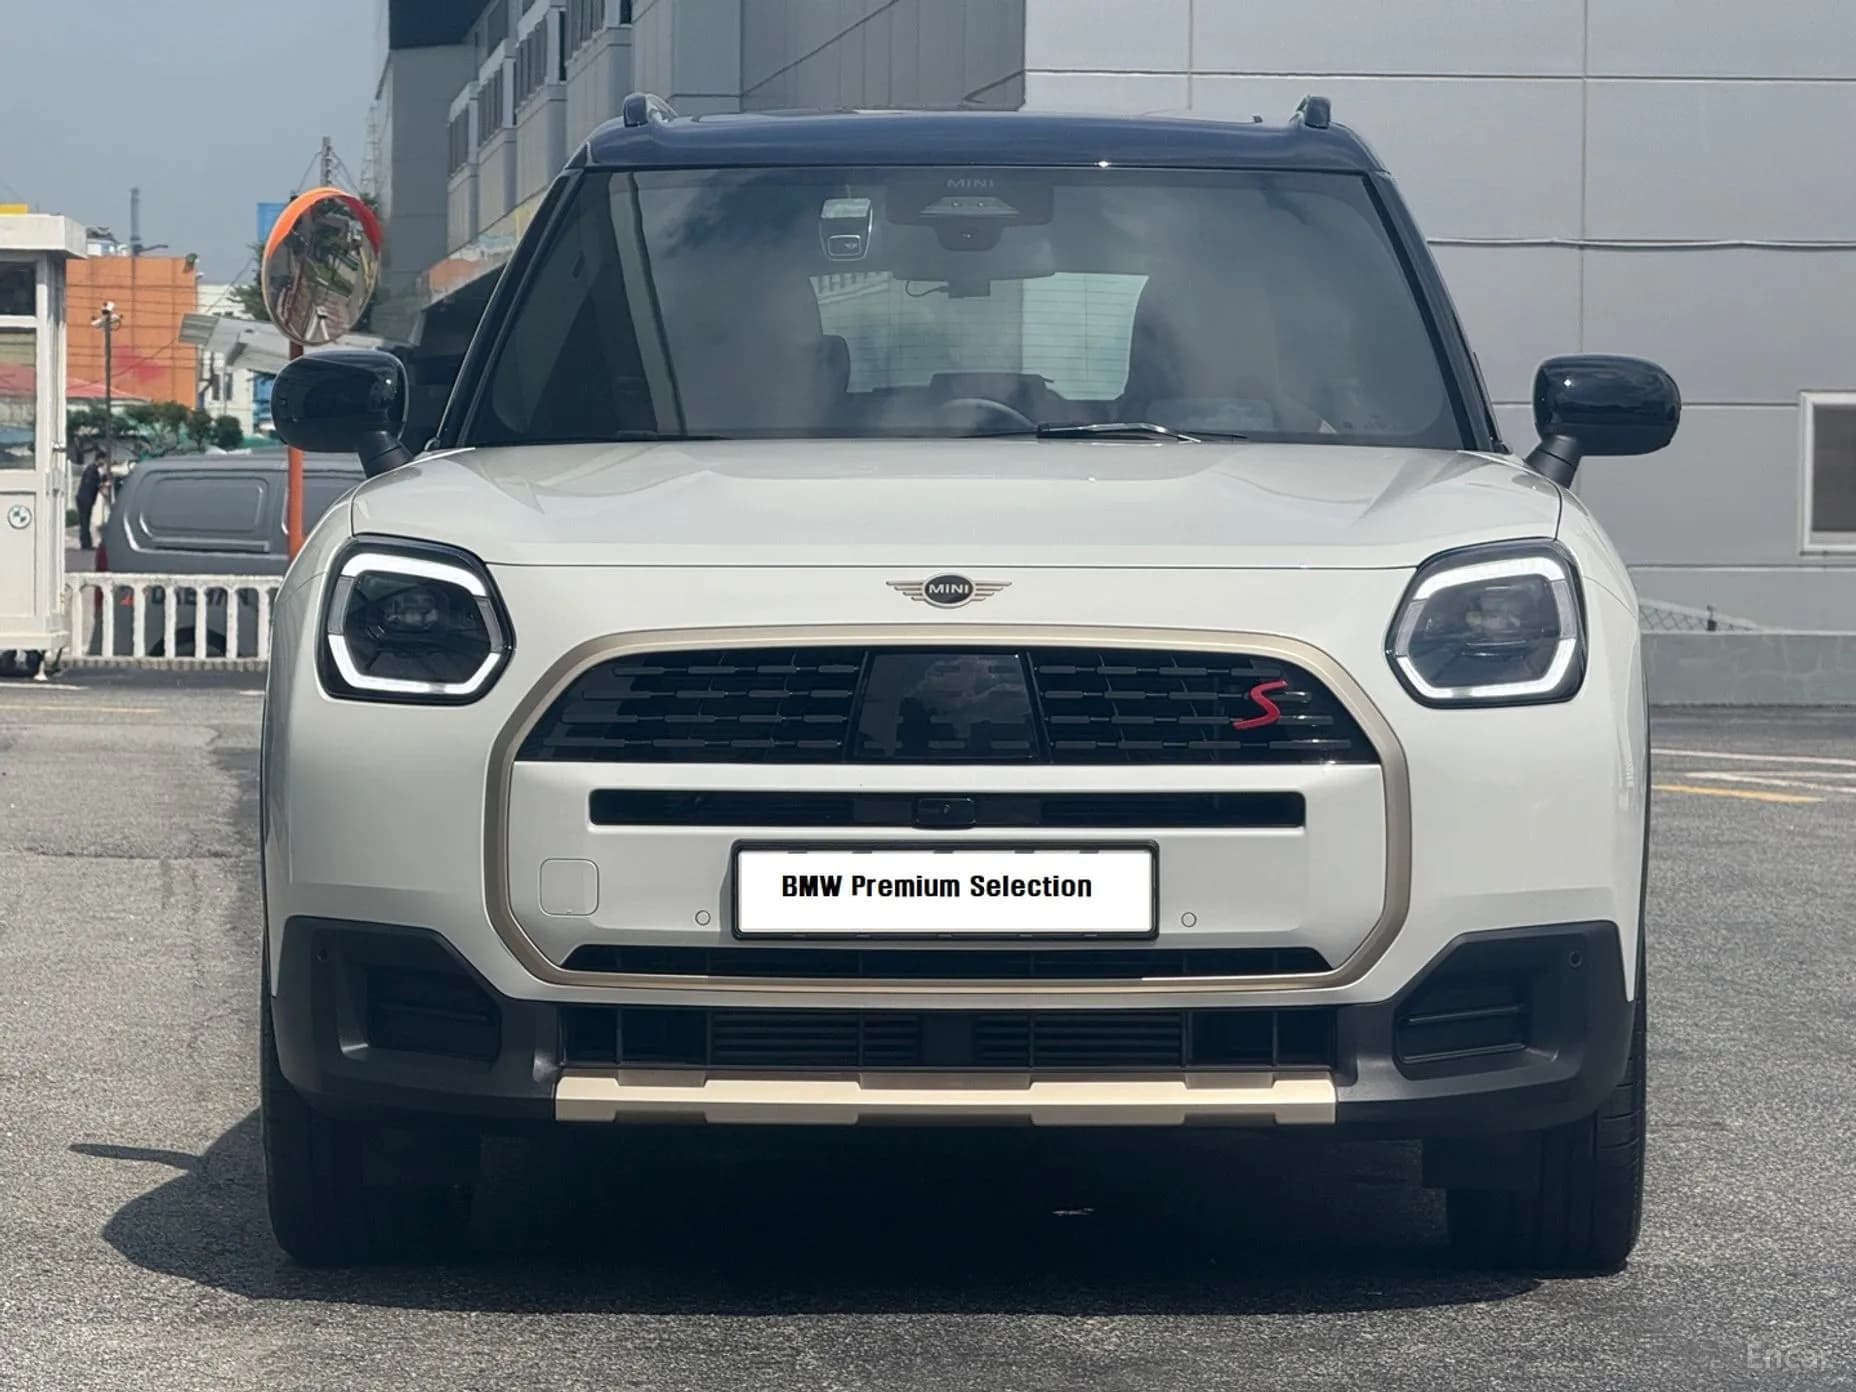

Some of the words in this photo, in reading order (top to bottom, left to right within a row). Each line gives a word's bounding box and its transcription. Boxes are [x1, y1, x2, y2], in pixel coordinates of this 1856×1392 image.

[947, 178, 995, 188] MINI
[928, 583, 970, 594] MINI
[1232, 680, 1288, 729] S
[782, 875, 843, 897] BMW
[852, 875, 961, 897] Premium
[970, 875, 1093, 897] Selection
